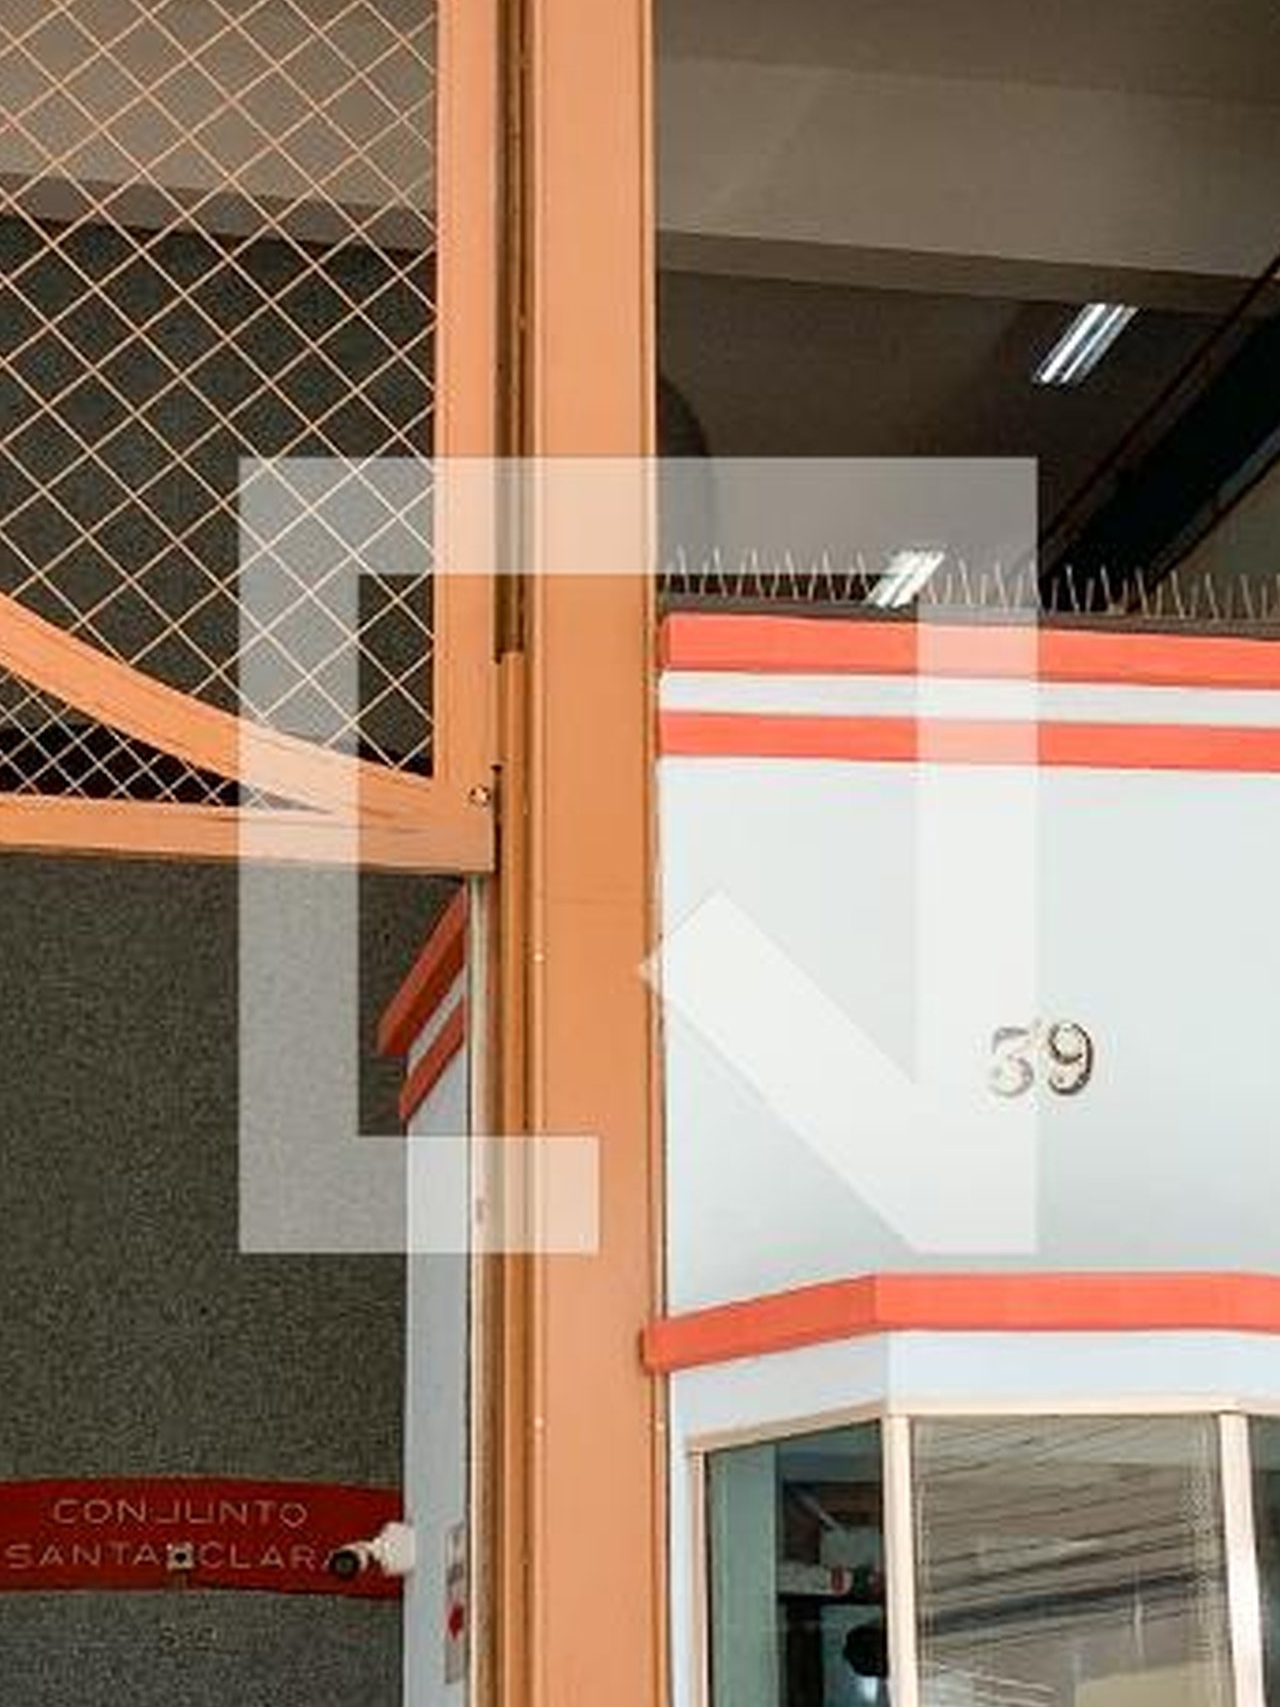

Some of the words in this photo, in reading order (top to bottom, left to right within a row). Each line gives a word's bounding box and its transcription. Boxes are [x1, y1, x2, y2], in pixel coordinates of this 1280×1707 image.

[987, 1020, 1094, 1096] 39
[53, 1497, 308, 1525] CONJUNTO
[6, 1540, 160, 1570] SANTA
[200, 1540, 332, 1571] CLAR
